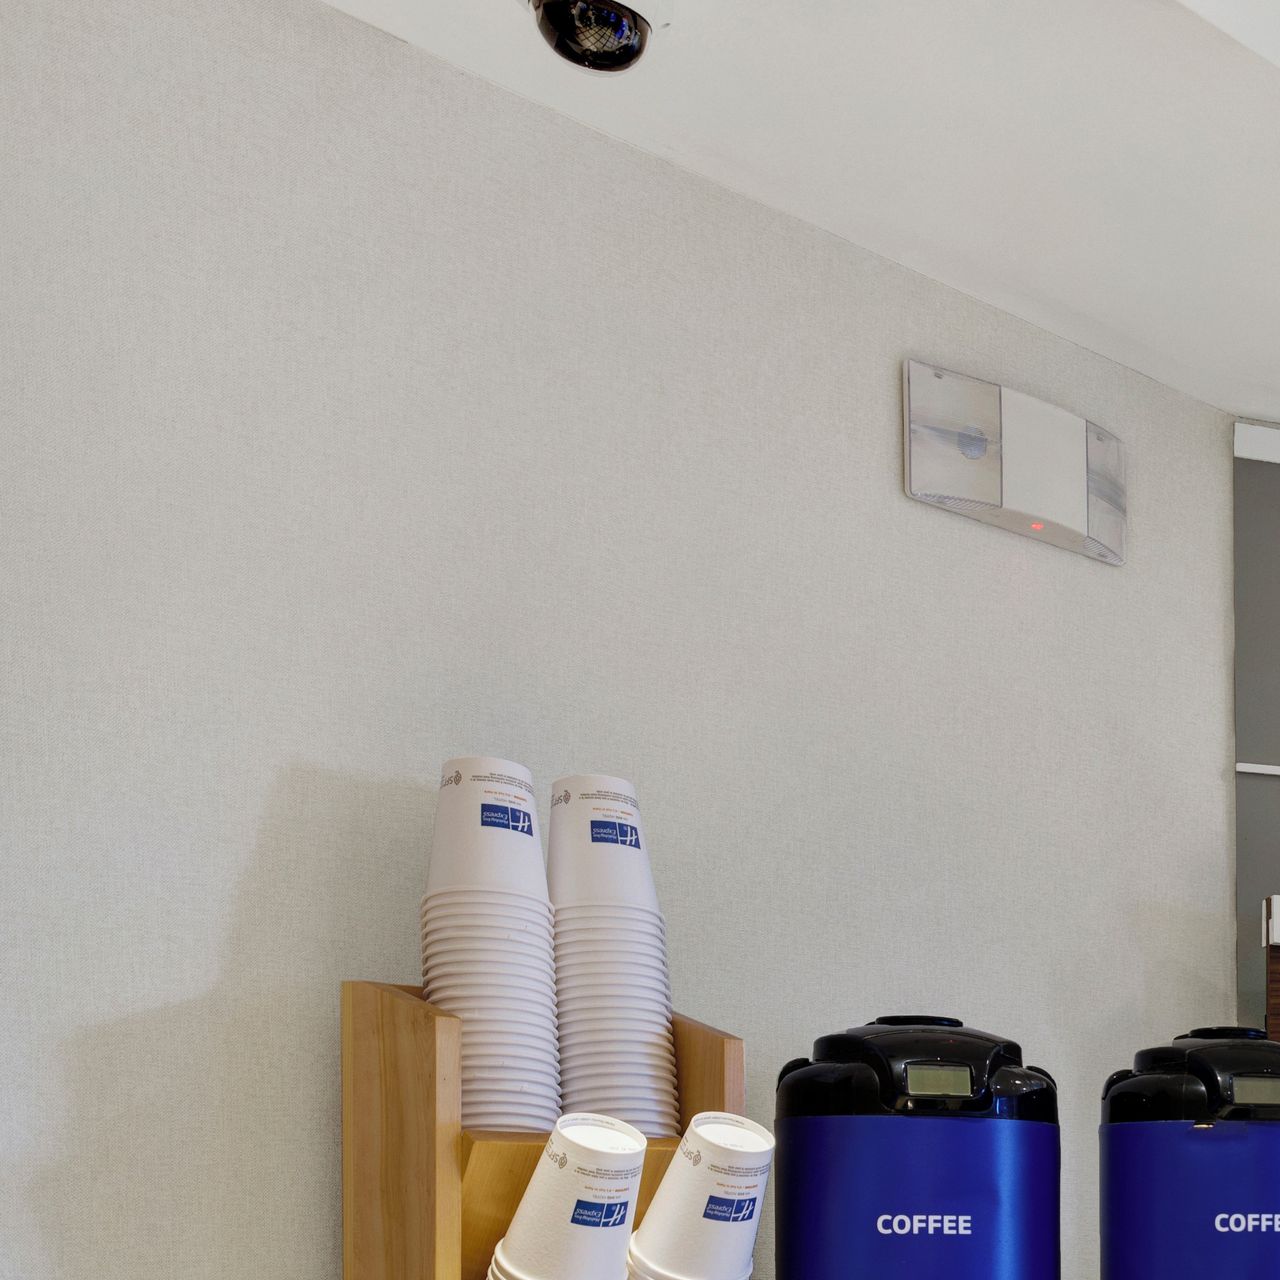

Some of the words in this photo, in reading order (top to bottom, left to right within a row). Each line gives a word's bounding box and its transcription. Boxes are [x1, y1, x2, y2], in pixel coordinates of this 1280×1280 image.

[482, 811, 508, 820] Express
[592, 827, 617, 835] Express
[707, 1203, 732, 1212] Express
[574, 1208, 602, 1217] Express
[876, 1214, 972, 1235] COFFEE
